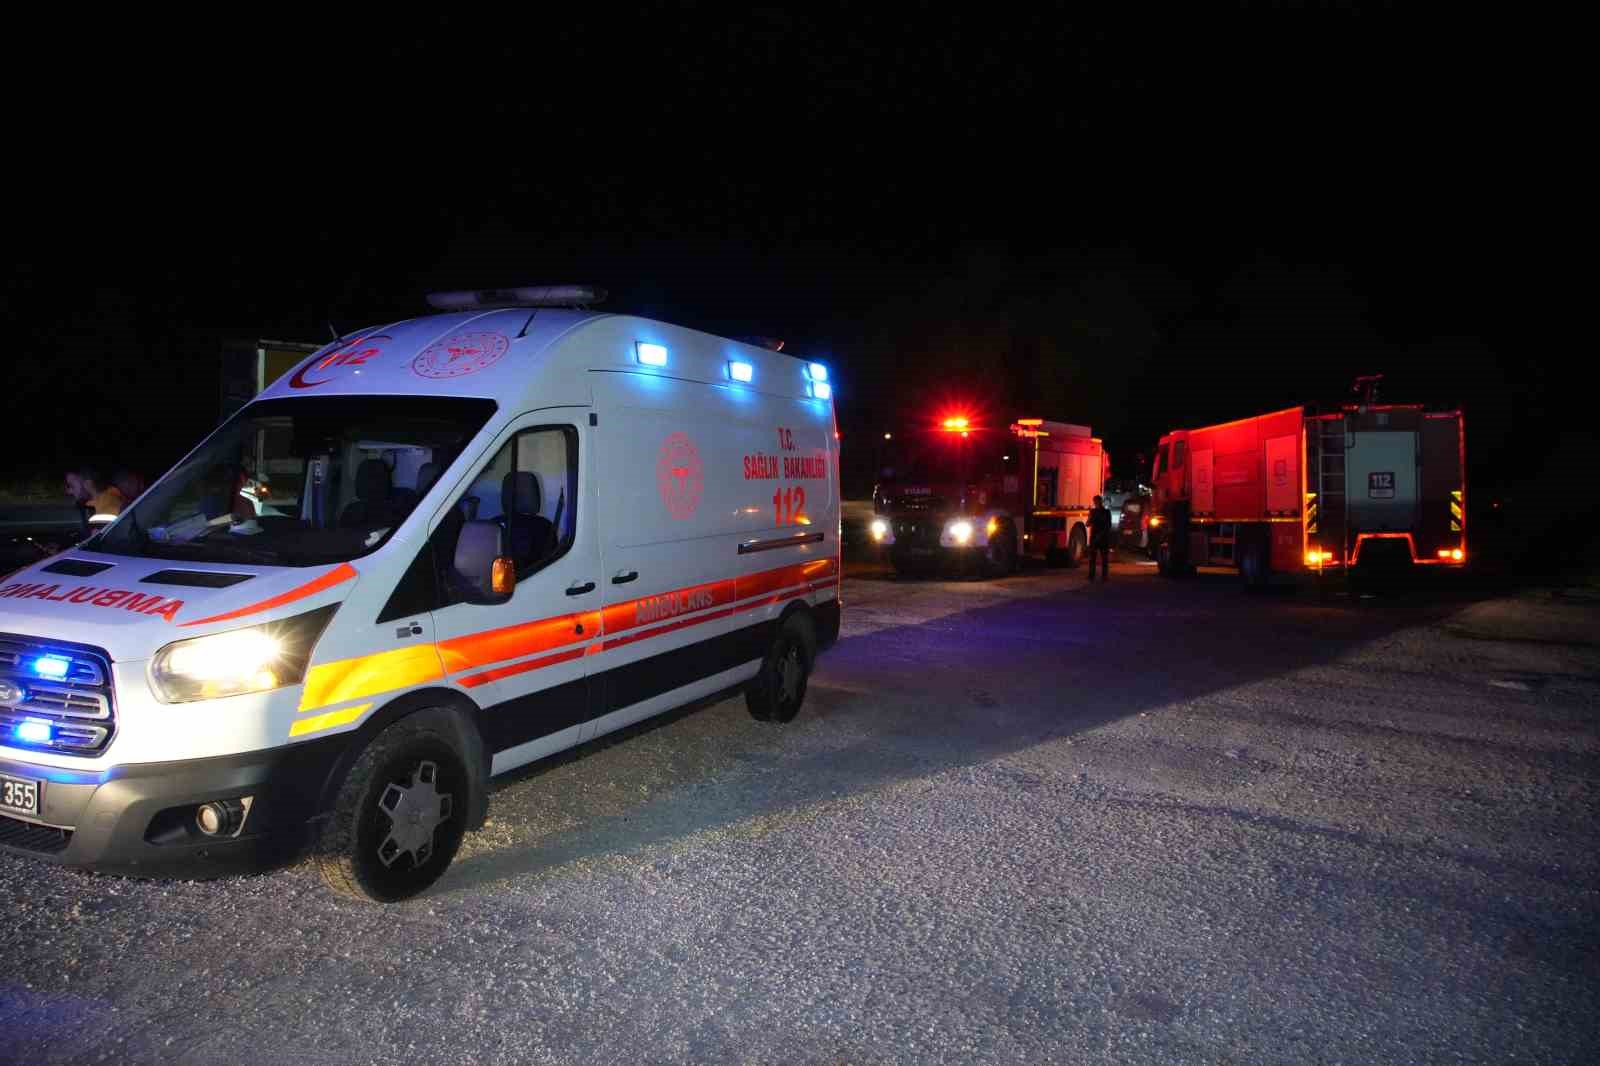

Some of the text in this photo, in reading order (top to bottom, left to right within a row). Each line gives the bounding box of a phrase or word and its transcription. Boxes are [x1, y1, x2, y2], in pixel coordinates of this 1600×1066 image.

[777, 427, 796, 451] T.C.
[743, 451, 780, 480] SAĞLIK
[1370, 474, 1392, 488] 112
[773, 486, 806, 528] 112
[635, 589, 713, 625] AMBULANS
[4, 781, 34, 809] 355
